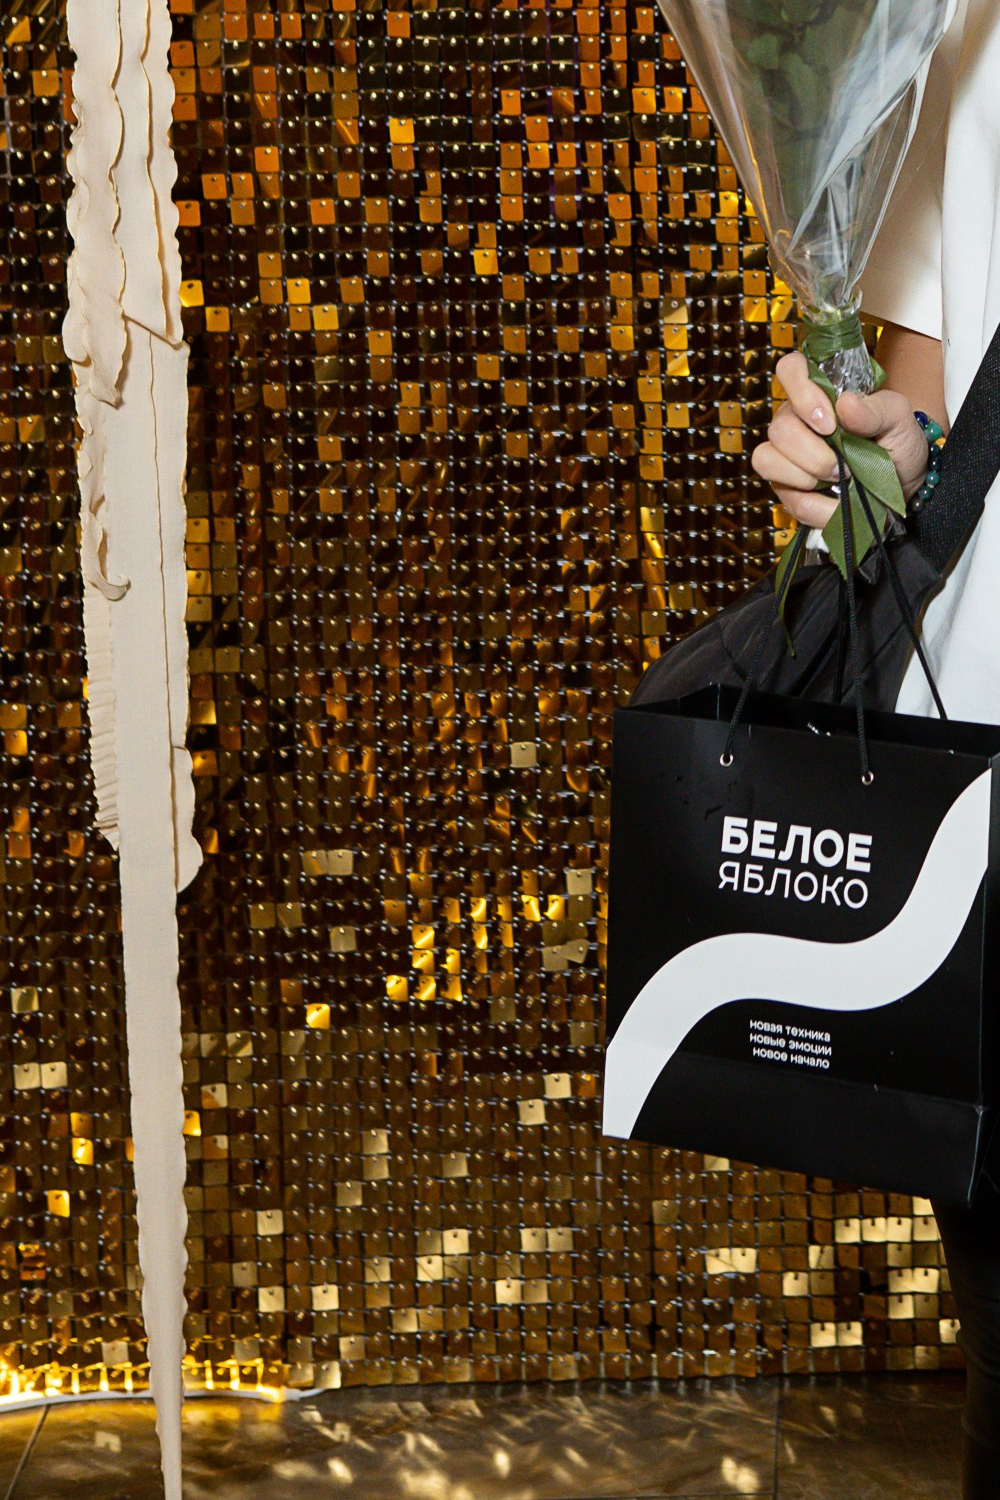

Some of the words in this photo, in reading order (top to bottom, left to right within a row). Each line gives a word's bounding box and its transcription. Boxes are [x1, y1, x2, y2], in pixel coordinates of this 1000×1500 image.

[720, 815, 873, 873] БЕЛОЕ
[718, 860, 869, 910] ЯБЛОКО
[749, 1019, 783, 1034] новая
[785, 1025, 831, 1043] техника
[749, 1032, 786, 1048] новые
[788, 1039, 832, 1056] эмоции
[752, 1046, 788, 1062] новое
[790, 1053, 830, 1069] начало
